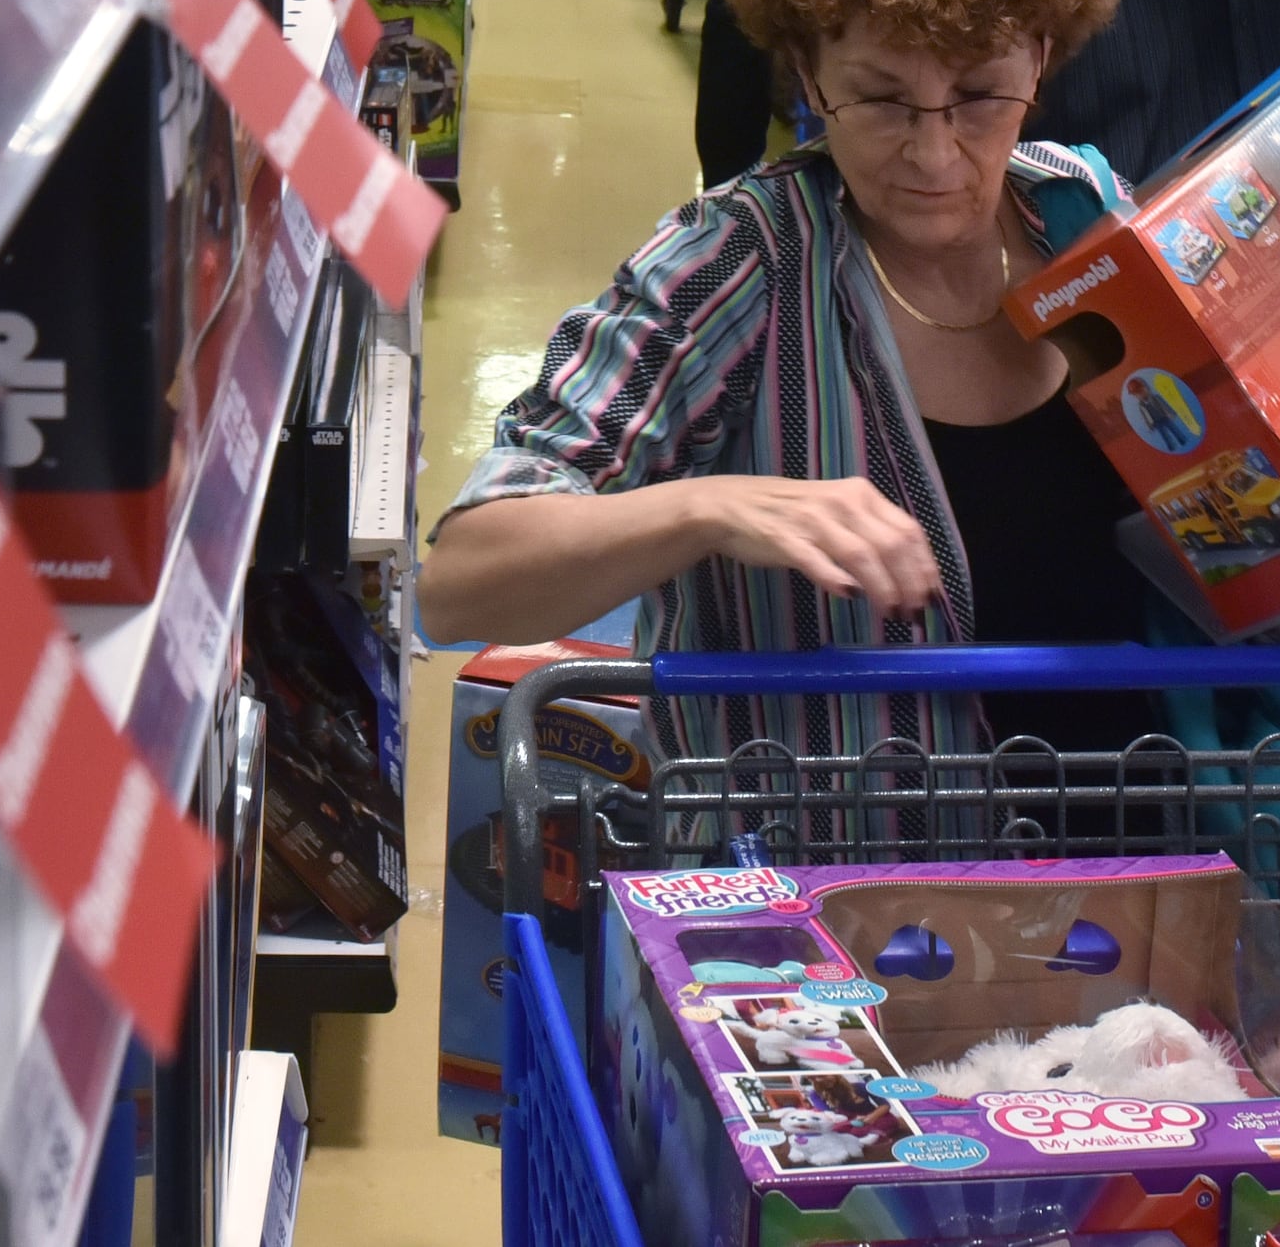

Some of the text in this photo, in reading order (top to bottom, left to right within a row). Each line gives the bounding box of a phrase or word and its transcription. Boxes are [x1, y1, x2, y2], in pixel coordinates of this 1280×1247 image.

[1032, 255, 1121, 323] playmobil
[628, 868, 775, 898] FurReal
[653, 884, 792, 915] friends
[1043, 1095, 1078, 1107] Up
[994, 1100, 1200, 1138] GoGo
[904, 1147, 982, 1163] Respond!
[1038, 1132, 1185, 1151] My Walkin' Pup
